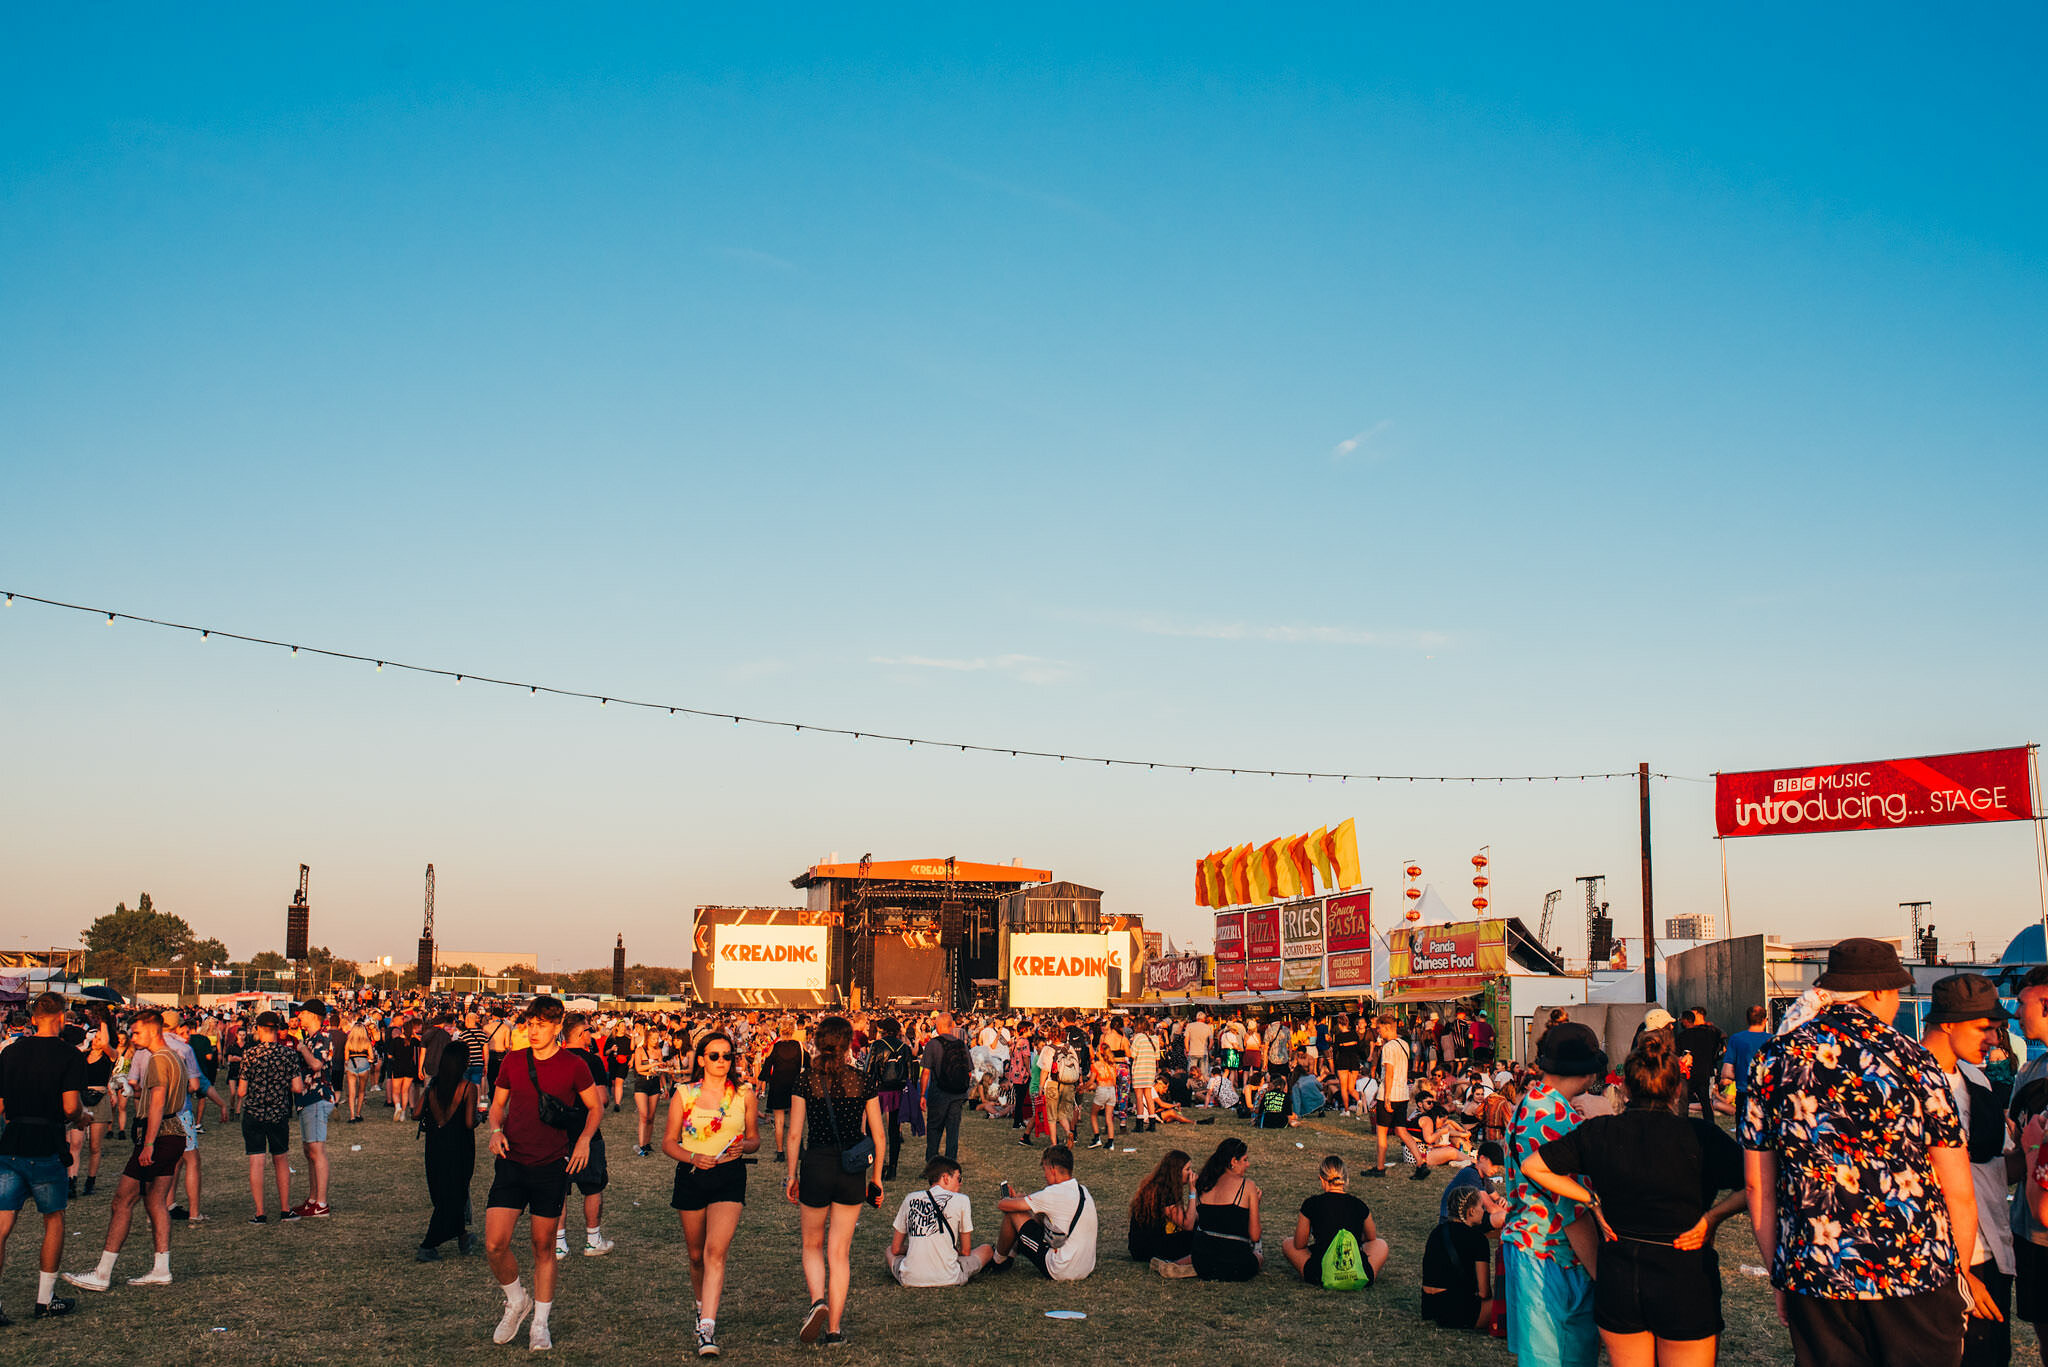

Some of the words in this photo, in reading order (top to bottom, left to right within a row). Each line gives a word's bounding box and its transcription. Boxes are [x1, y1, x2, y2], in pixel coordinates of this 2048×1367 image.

[1774, 776, 1816, 793] BBC
[1819, 772, 1871, 789] MUSIC
[1735, 791, 1925, 826] introducing...
[1930, 786, 2007, 813] STAGE
[920, 864, 960, 875] READG
[1328, 902, 1356, 920] Saucy
[1284, 907, 1320, 939] FRIES
[1328, 914, 1367, 937] PASTA
[1217, 925, 1242, 940] PIZZERIA
[1249, 922, 1276, 944] PIZZA
[740, 944, 818, 963] READING
[1304, 943, 1323, 954] FRIES
[1429, 939, 1456, 954] Panda
[1332, 955, 1363, 969] macaroni
[1413, 955, 1449, 971] Chinese
[1450, 952, 1475, 969] Food
[1336, 968, 1360, 980] cheese
[909, 1198, 932, 1216] VANS
